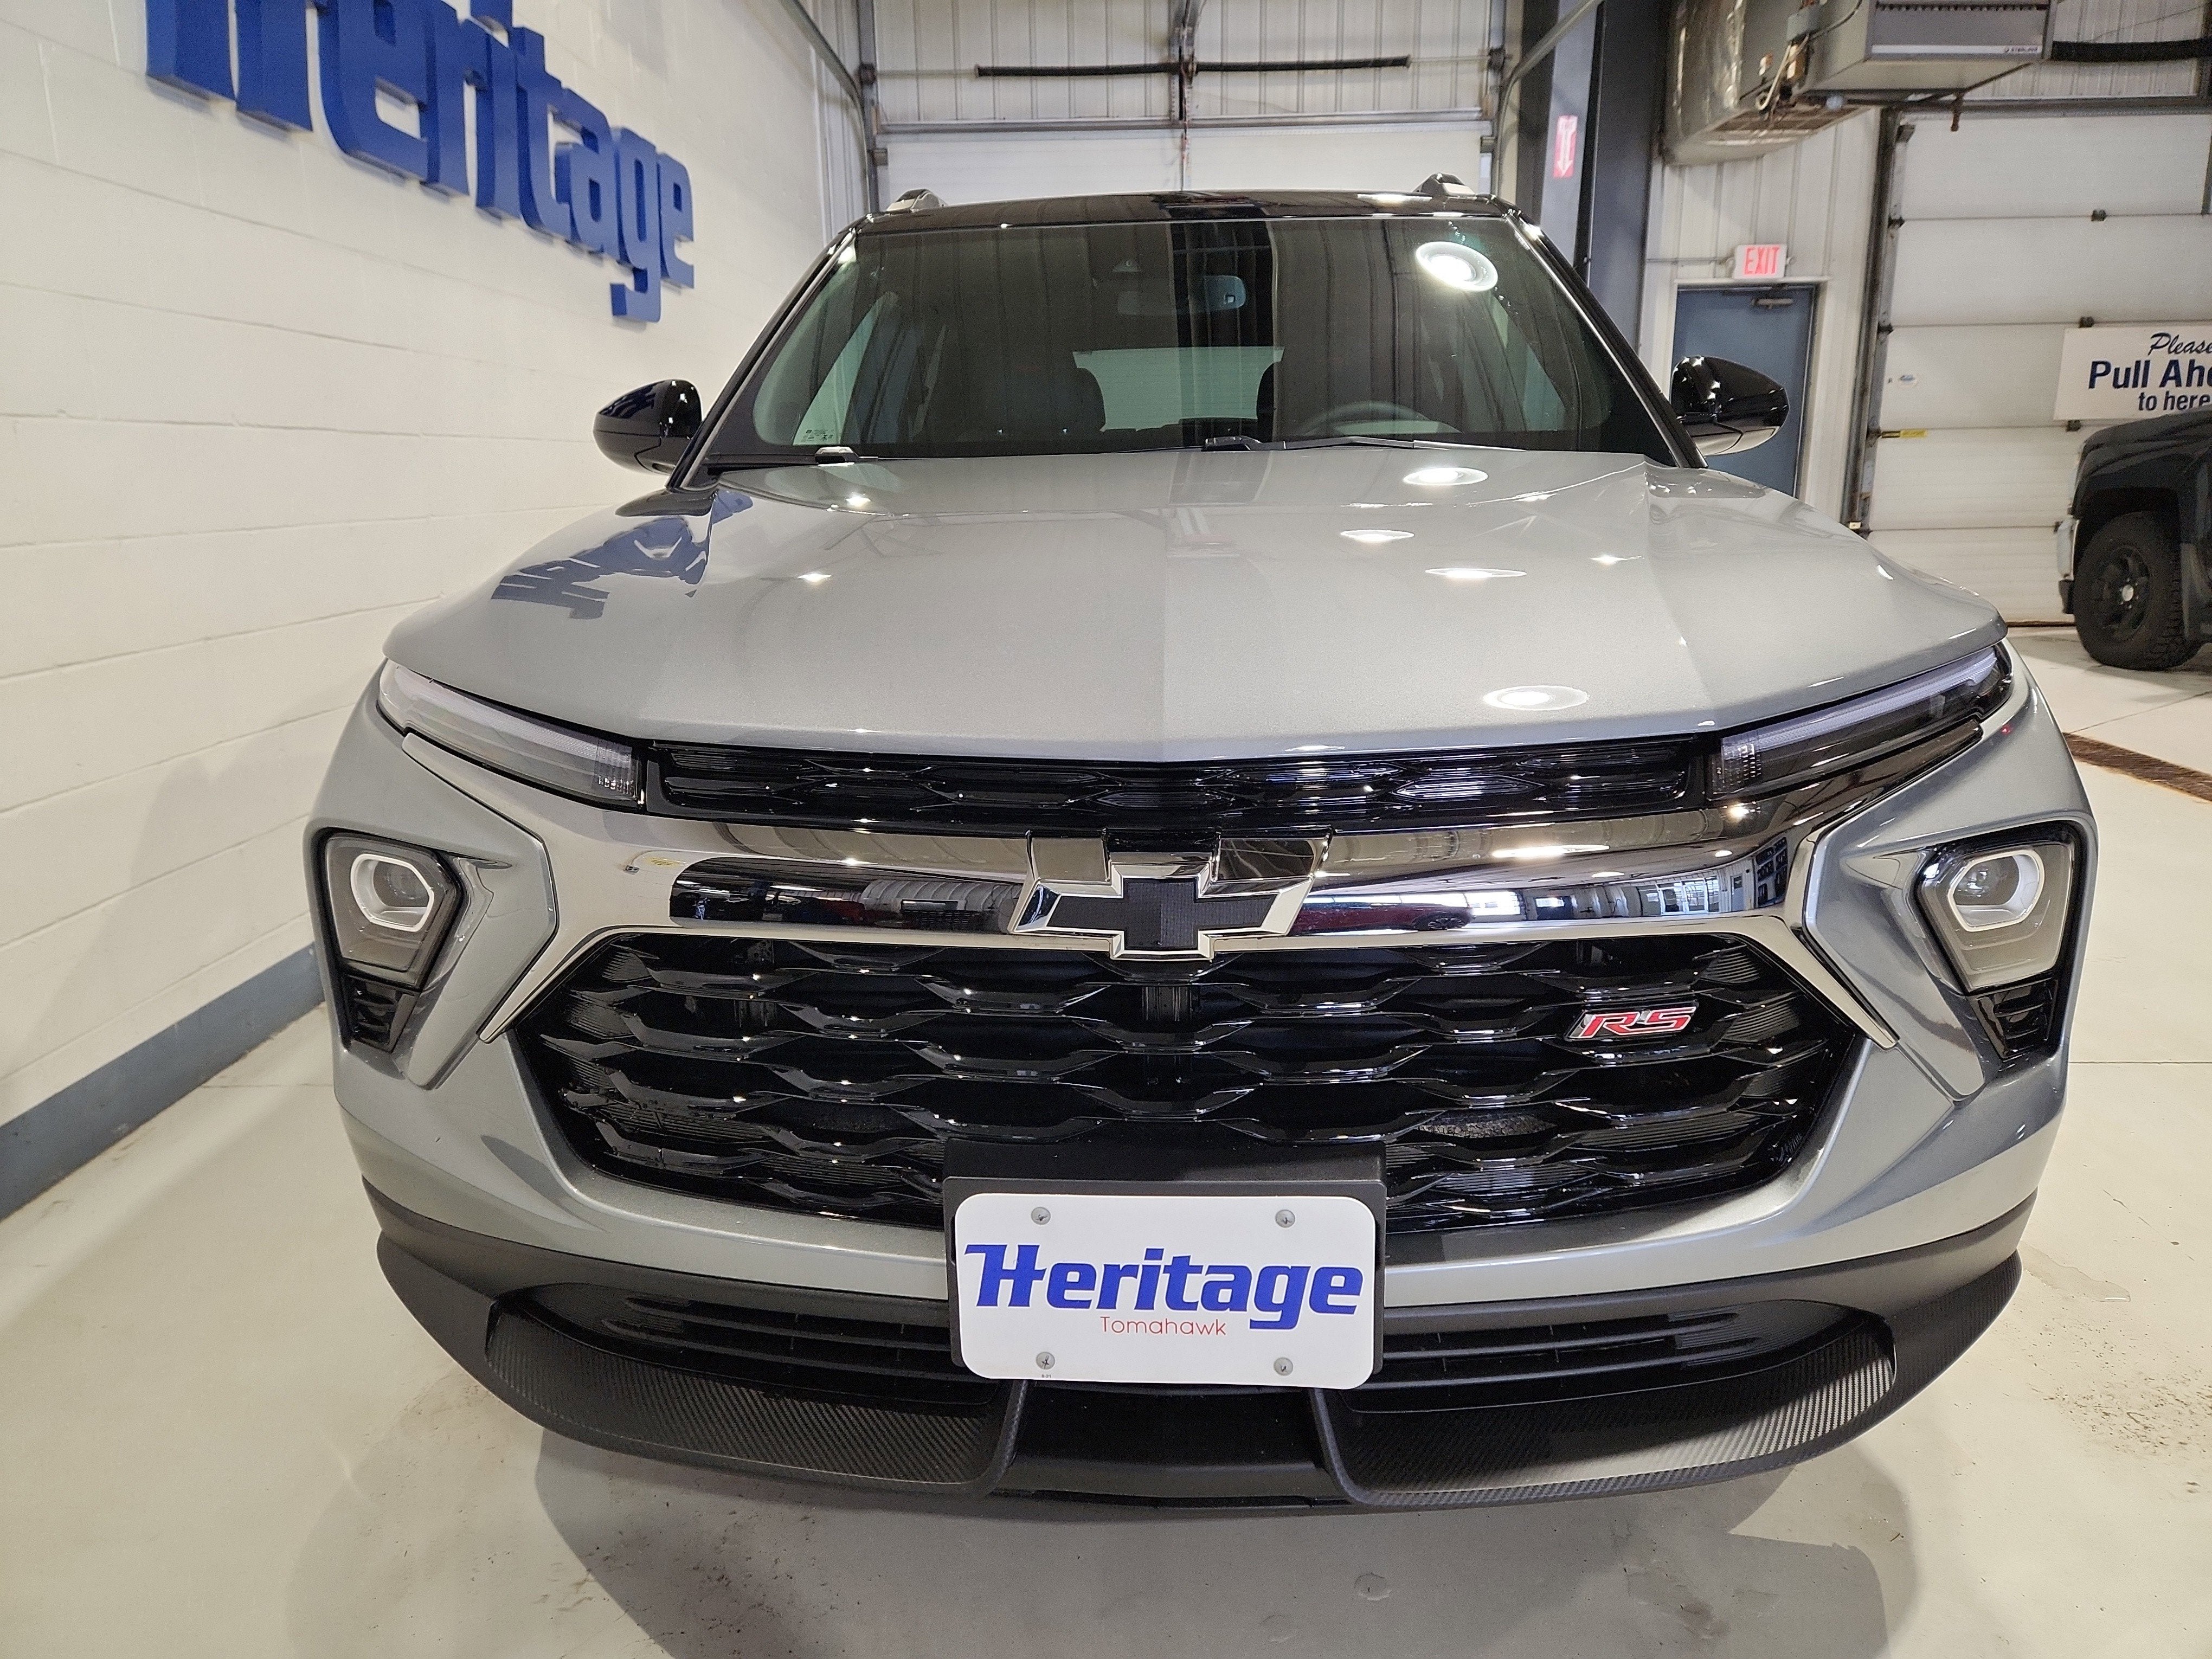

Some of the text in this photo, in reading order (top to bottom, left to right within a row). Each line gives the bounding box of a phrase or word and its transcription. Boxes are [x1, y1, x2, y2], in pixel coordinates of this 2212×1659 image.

[1744, 247, 1779, 274] EXIT
[2088, 359, 2150, 389] Pull
[2138, 392, 2157, 410] to
[1570, 1006, 1696, 1038] RS
[964, 1244, 1363, 1329] Heritage
[1100, 1316, 1227, 1336] Tomahawk
